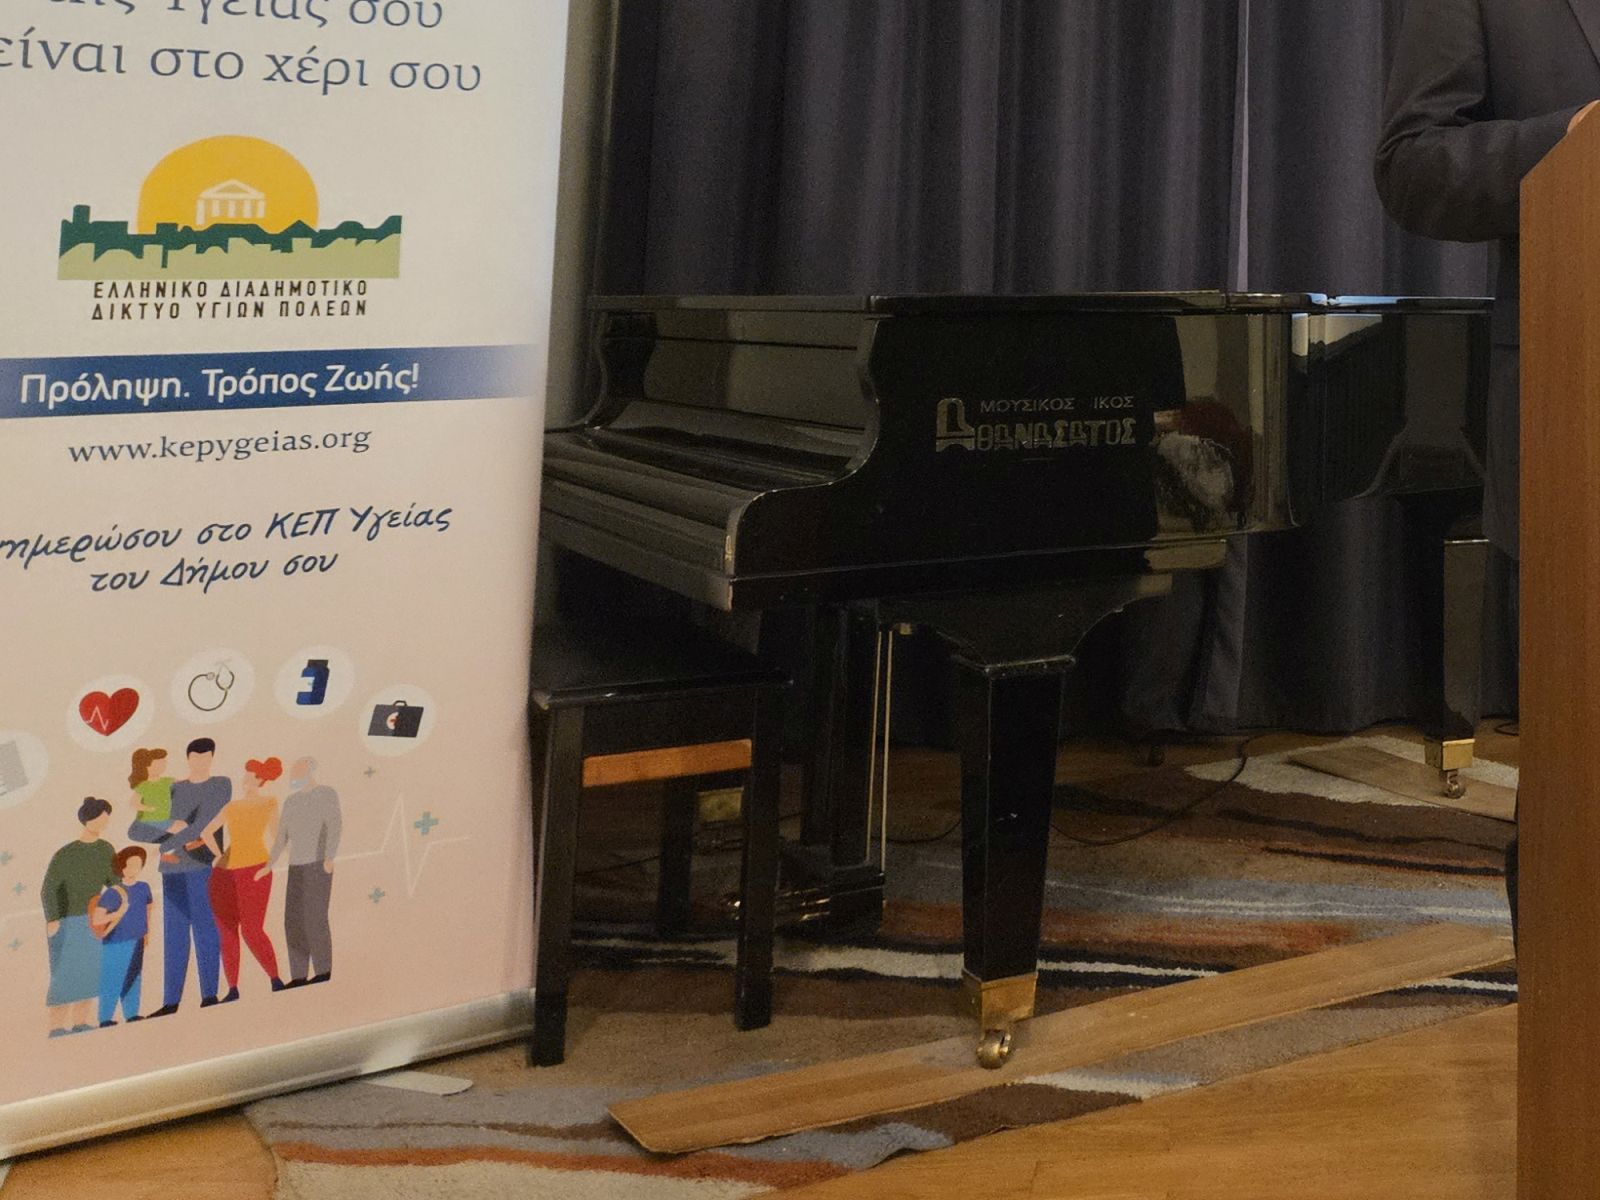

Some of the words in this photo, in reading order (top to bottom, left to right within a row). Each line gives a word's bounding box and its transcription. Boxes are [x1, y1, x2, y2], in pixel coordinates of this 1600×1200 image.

[150, 46, 245, 80] στο
[262, 45, 368, 95] χέρι
[390, 61, 482, 92] σου
[94, 280, 207, 299] ΕΛΛΗΝΙΚΟ
[220, 279, 368, 298] ΔΙΑΔΗΜΟΤΙΚΟ
[91, 302, 180, 320] ΔΙΚΤΥΟ
[196, 301, 264, 319] ΥΓΙΩΝ
[279, 299, 367, 317] ΠΟΛΕΩΝ
[20, 372, 191, 410] Πρόληψη.
[201, 366, 317, 404] Τρόπος
[324, 362, 421, 394] Ζωής!
[980, 397, 1076, 413] ΜΟΥΣΙΚΟΣ
[1087, 395, 1134, 409] ΙΚΟΣ
[68, 429, 373, 464] www.kepygeias.org
[197, 523, 252, 546] στο
[265, 506, 341, 540] ΚΕΠ
[349, 502, 453, 542] Υγείας
[90, 570, 151, 593] του
[159, 556, 269, 595] Δήμου
[283, 553, 339, 577] σου
